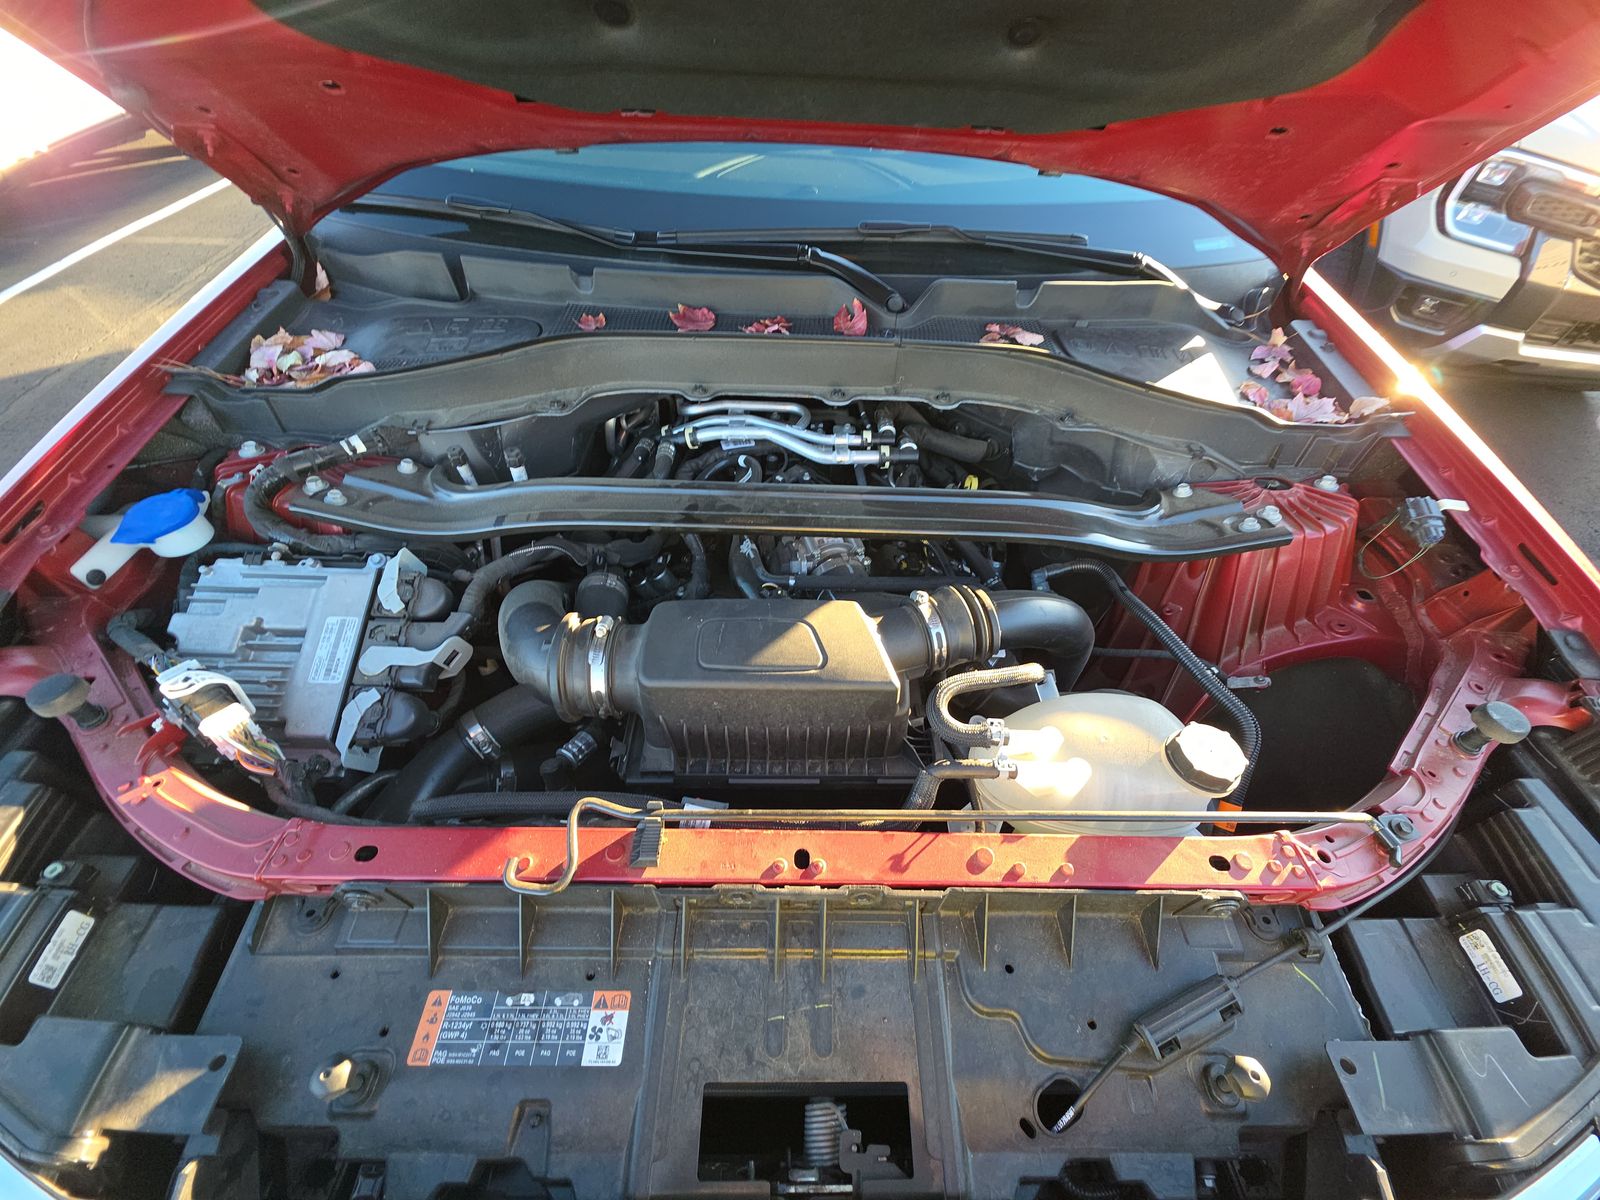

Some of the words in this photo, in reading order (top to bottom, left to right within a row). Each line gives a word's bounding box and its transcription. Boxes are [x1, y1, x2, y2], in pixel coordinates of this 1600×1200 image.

[1476, 961, 1503, 996] LH-CG
[449, 995, 482, 1004] FoMoCo
[442, 1021, 473, 1030] R-1234yf
[433, 1049, 448, 1057] PAG
[431, 1057, 446, 1065] POE
